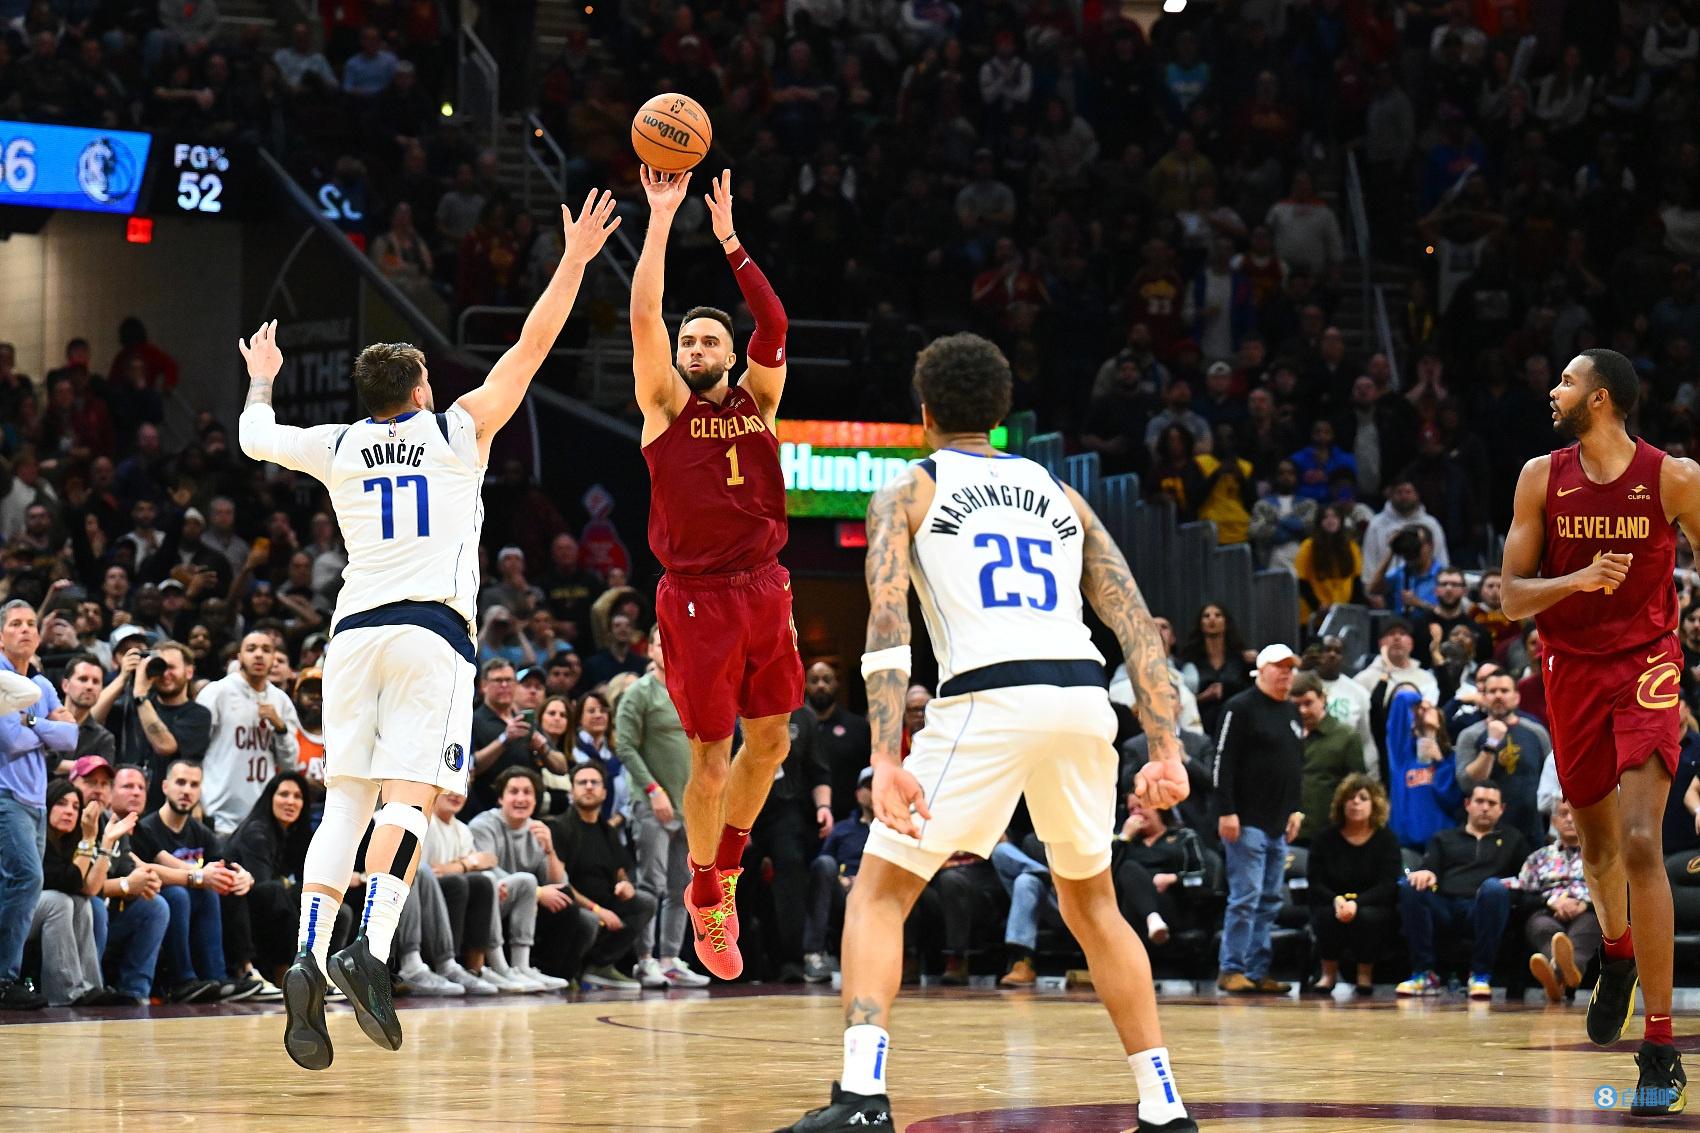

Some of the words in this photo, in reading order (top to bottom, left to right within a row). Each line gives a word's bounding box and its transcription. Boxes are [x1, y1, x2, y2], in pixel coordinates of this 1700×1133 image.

[642, 114, 690, 148] Wilson
[0, 138, 36, 193] 6
[173, 142, 229, 172] FG%
[177, 171, 223, 213] 52
[690, 414, 766, 439] CLEVELAD
[360, 438, 427, 469] DONČIĆ
[725, 443, 745, 486] 1
[779, 442, 922, 492] Huntin
[362, 474, 430, 540] 77
[930, 484, 1050, 536] WASHINGTON
[1556, 515, 1650, 539] CLEVELAND
[973, 532, 1058, 612] 25
[246, 756, 268, 783] 10
